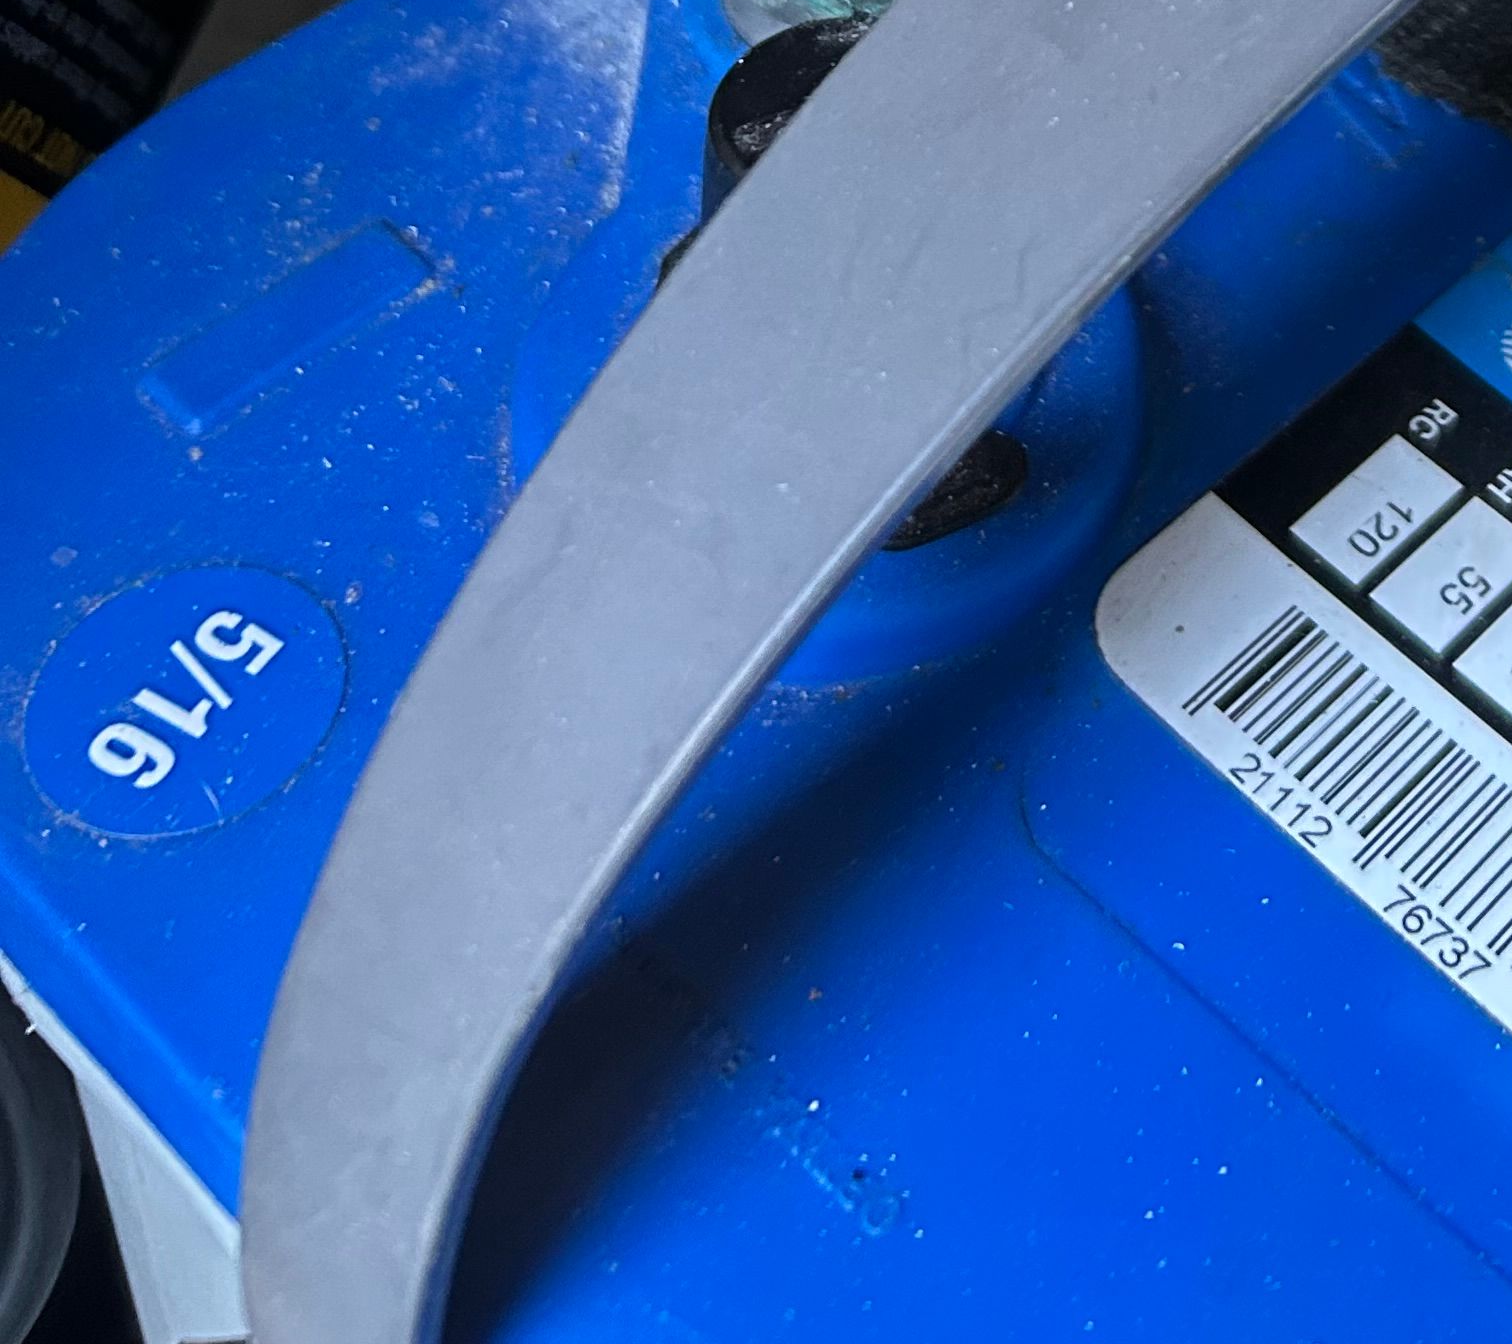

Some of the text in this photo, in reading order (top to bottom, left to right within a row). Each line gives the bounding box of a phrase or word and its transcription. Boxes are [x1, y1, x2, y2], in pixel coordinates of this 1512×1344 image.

[1410, 399, 1459, 441] RC
[1348, 502, 1413, 559] 120
[1440, 567, 1493, 616] 55
[86, 608, 285, 792] 5/16
[1229, 752, 1333, 848] 21112
[1383, 884, 1492, 980] 76737
